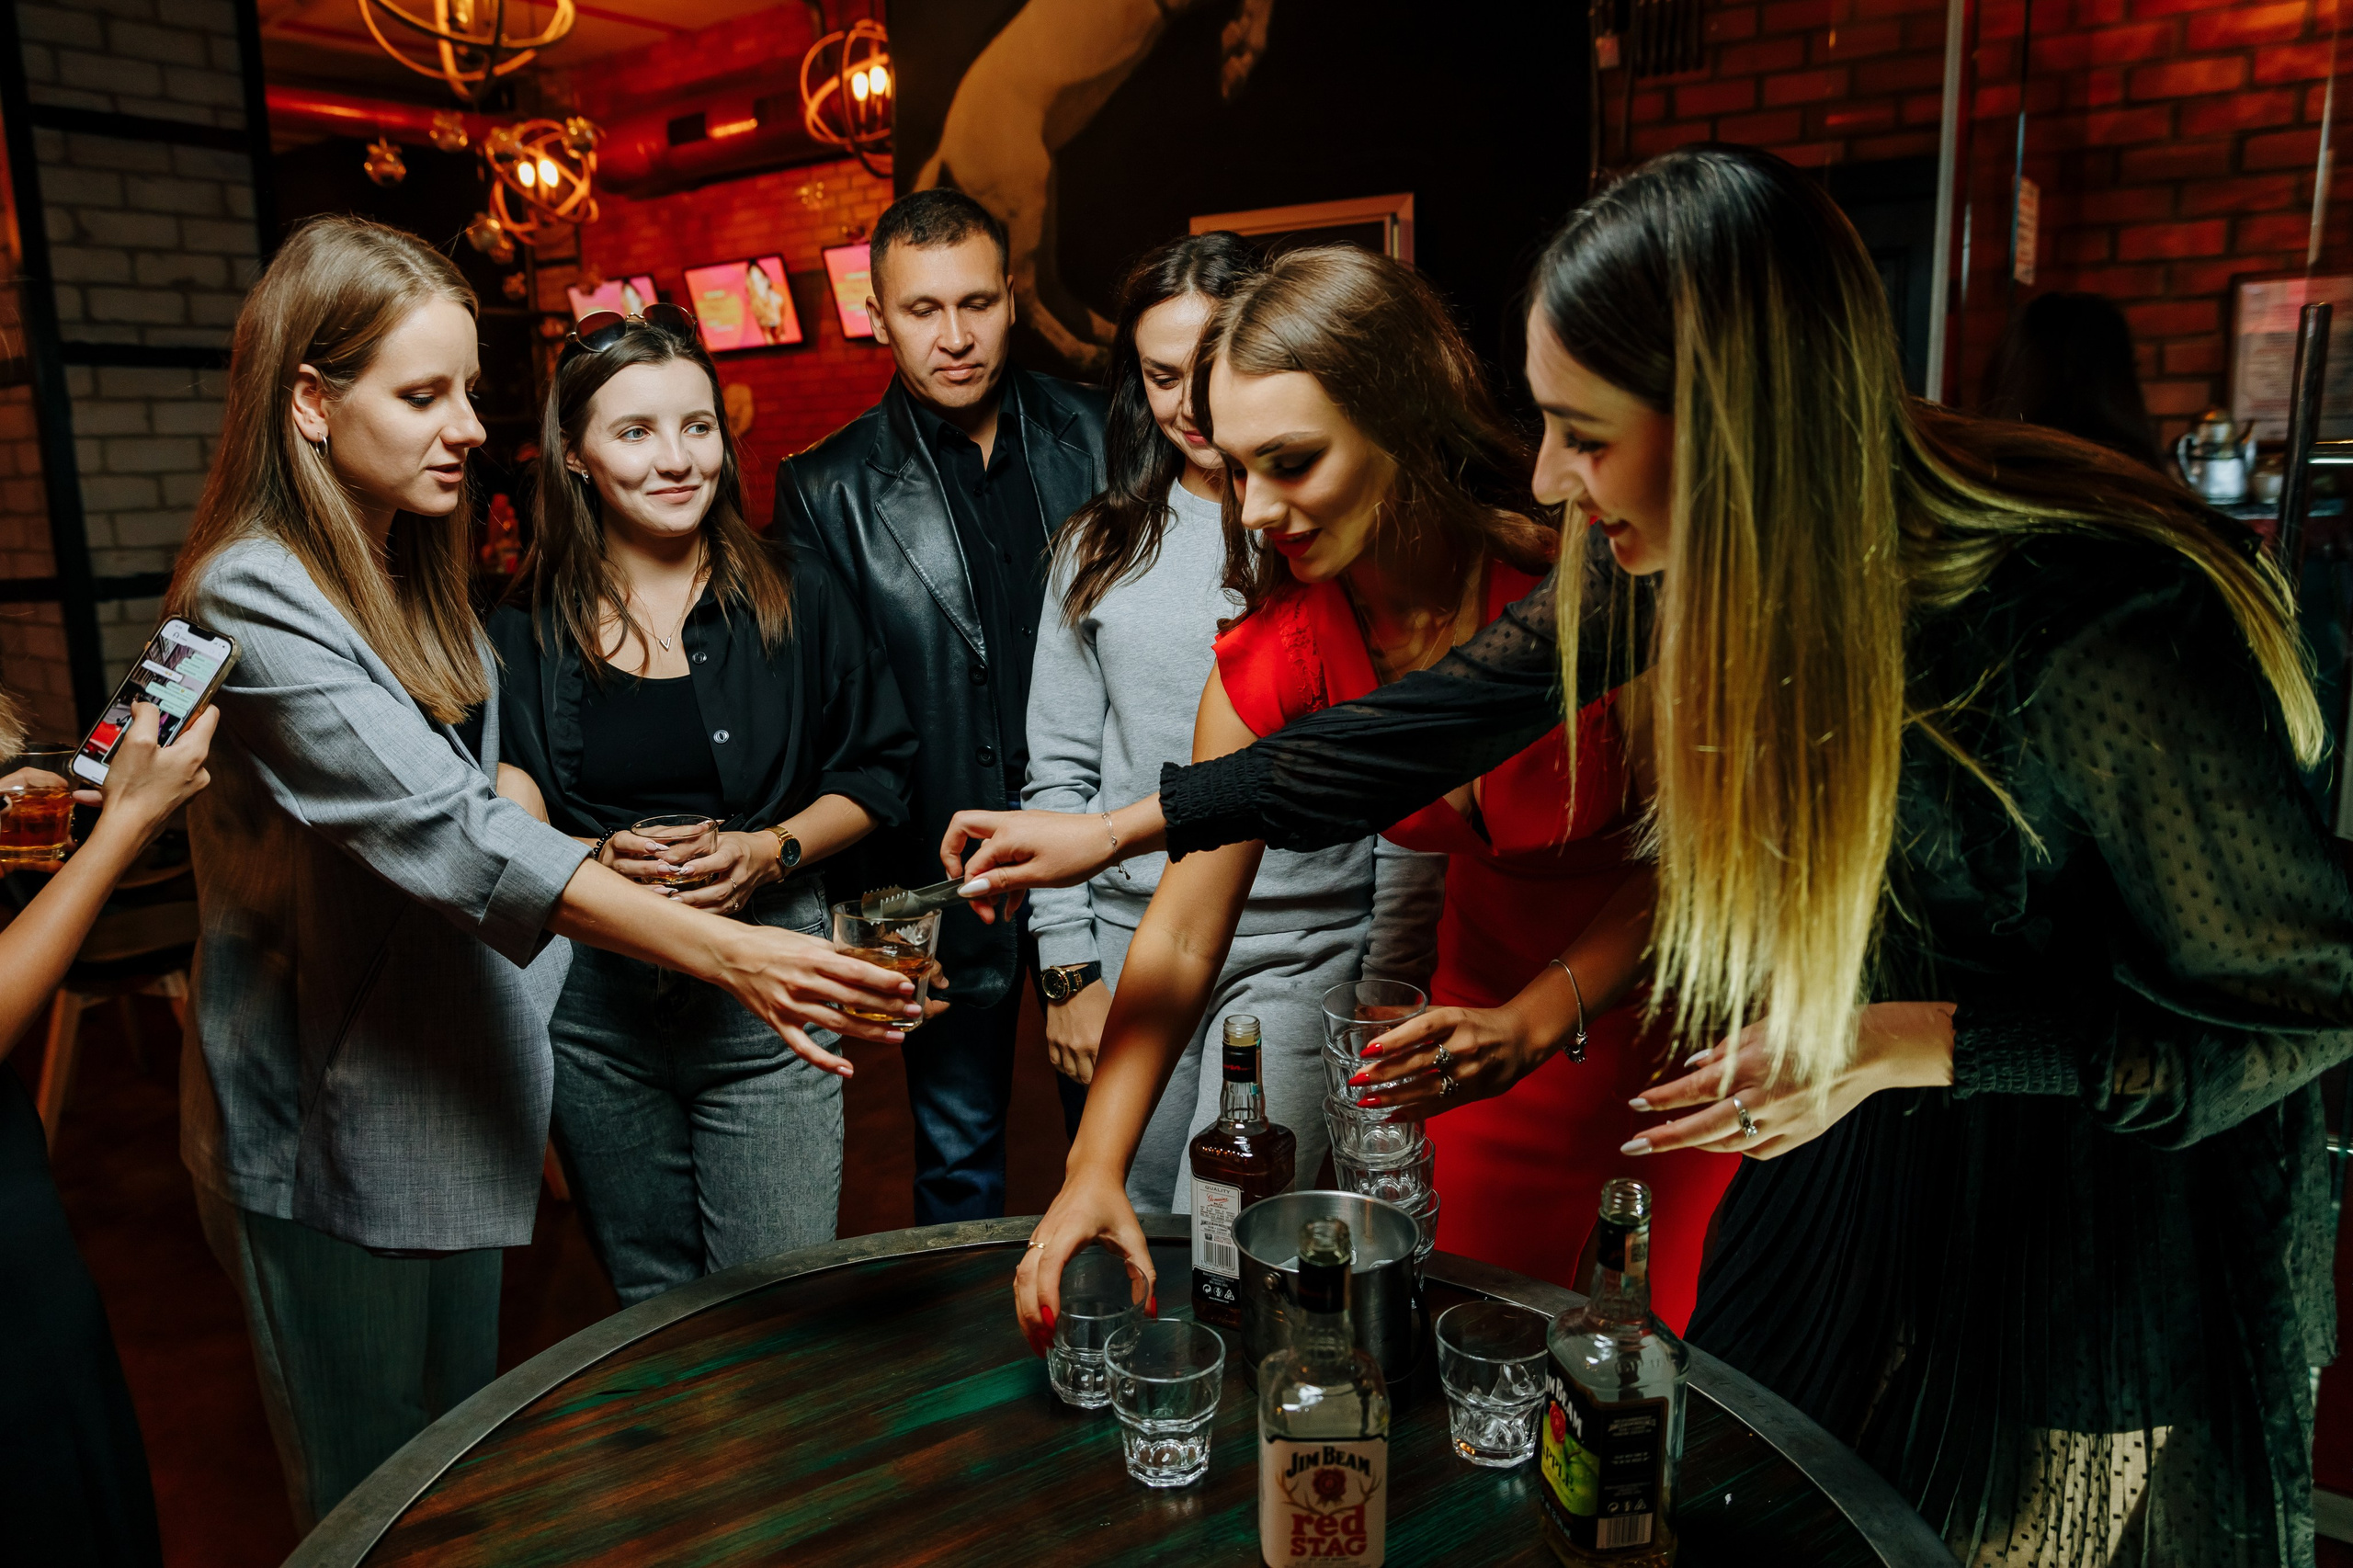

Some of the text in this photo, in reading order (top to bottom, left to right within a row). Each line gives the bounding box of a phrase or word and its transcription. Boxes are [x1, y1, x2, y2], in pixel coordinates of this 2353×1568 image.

[1204, 1185, 1231, 1194] QUALITY
[1545, 1375, 1583, 1439] IM BEAM
[1286, 1446, 1370, 1478] JIM BEAM
[1291, 1504, 1367, 1537] red
[1290, 1536, 1368, 1557] STAG
